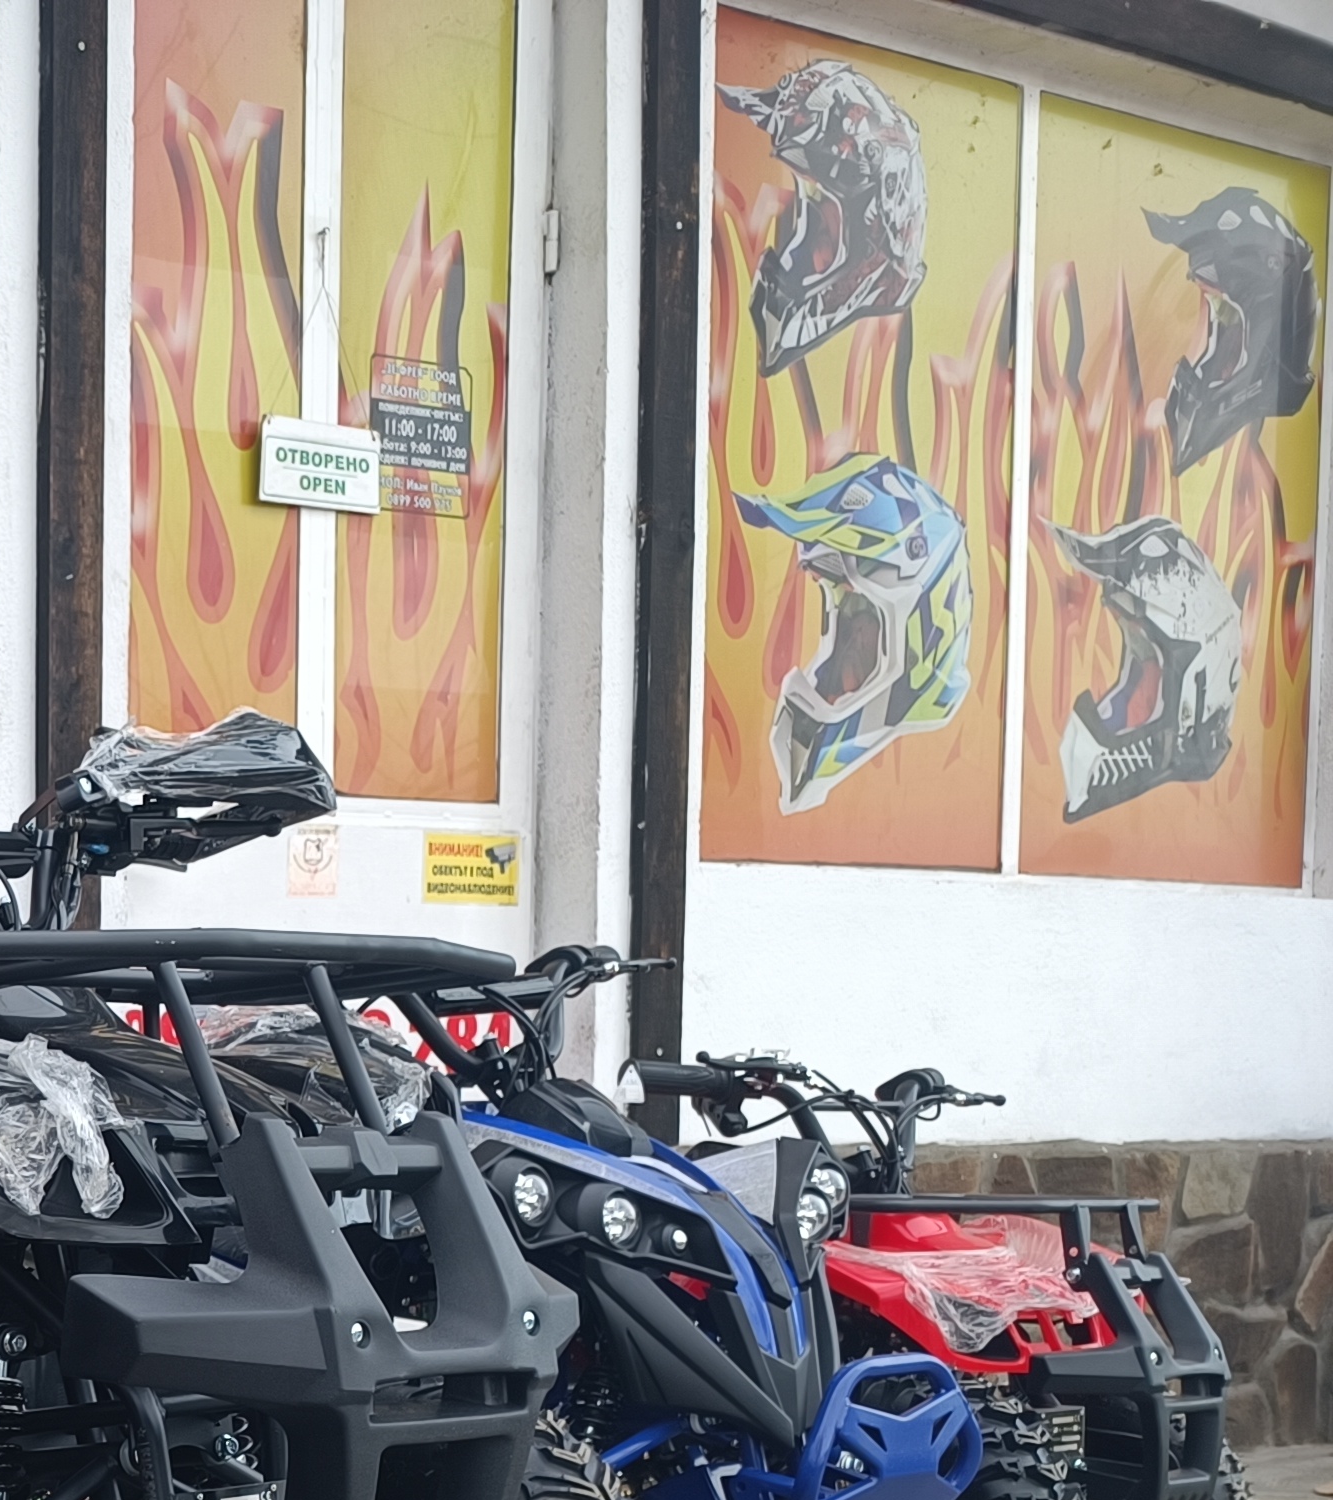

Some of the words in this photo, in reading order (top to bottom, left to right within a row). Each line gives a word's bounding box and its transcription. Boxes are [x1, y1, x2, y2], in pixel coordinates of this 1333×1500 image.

[380, 383, 429, 402] РАБОТНО
[430, 390, 461, 406] ВРЕМЕ
[384, 417, 415, 438] 11:00
[427, 423, 457, 443] 17:00
[275, 446, 370, 474] ОТВОРЕНО
[410, 441, 432, 455] 9:00
[441, 445, 467, 460] 13:00
[299, 474, 346, 496] OPEN
[476, 866, 494, 878] ПОД
